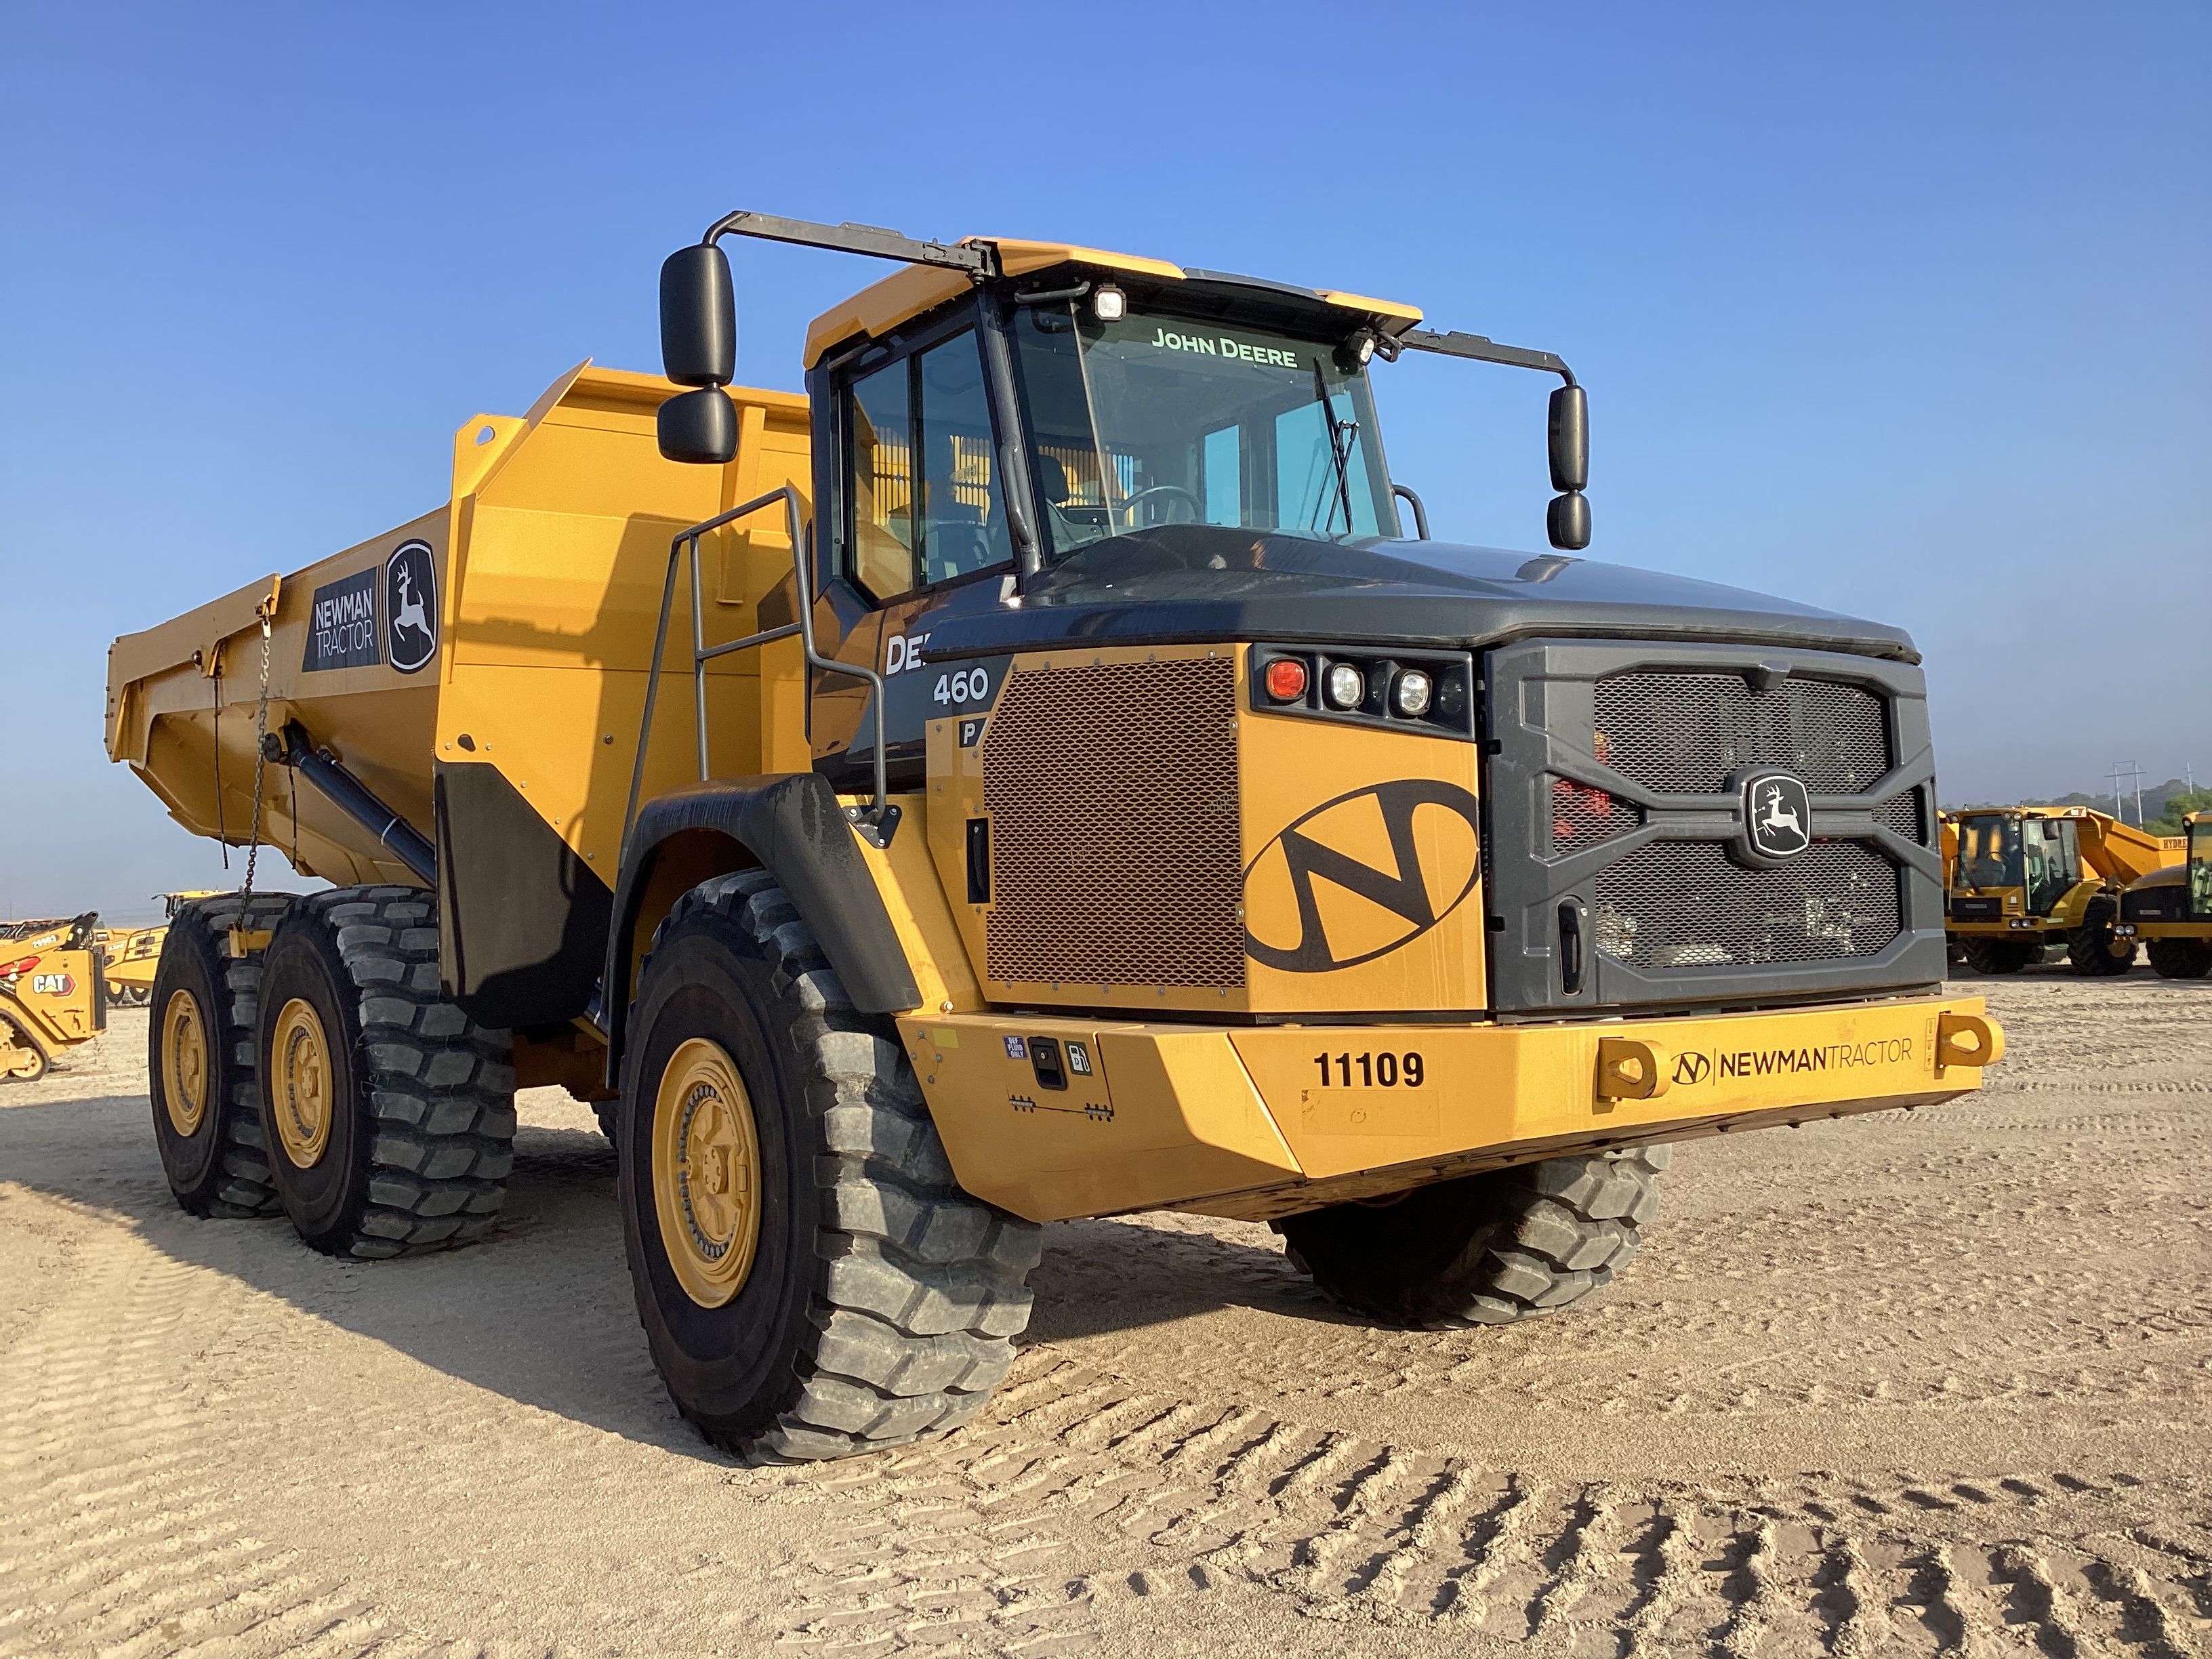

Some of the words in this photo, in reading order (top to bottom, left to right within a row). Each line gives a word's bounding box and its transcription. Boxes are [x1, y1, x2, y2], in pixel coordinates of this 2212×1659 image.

[1152, 328, 1216, 355] JOHN
[1219, 337, 1298, 368] DEERE
[315, 588, 373, 630] NEWMAN
[316, 619, 373, 659] TRACTOR
[886, 633, 931, 676] DE
[933, 667, 989, 705] 460
[963, 722, 976, 744] P
[33, 975, 66, 994] CAT
[1313, 1052, 1425, 1088] 11109
